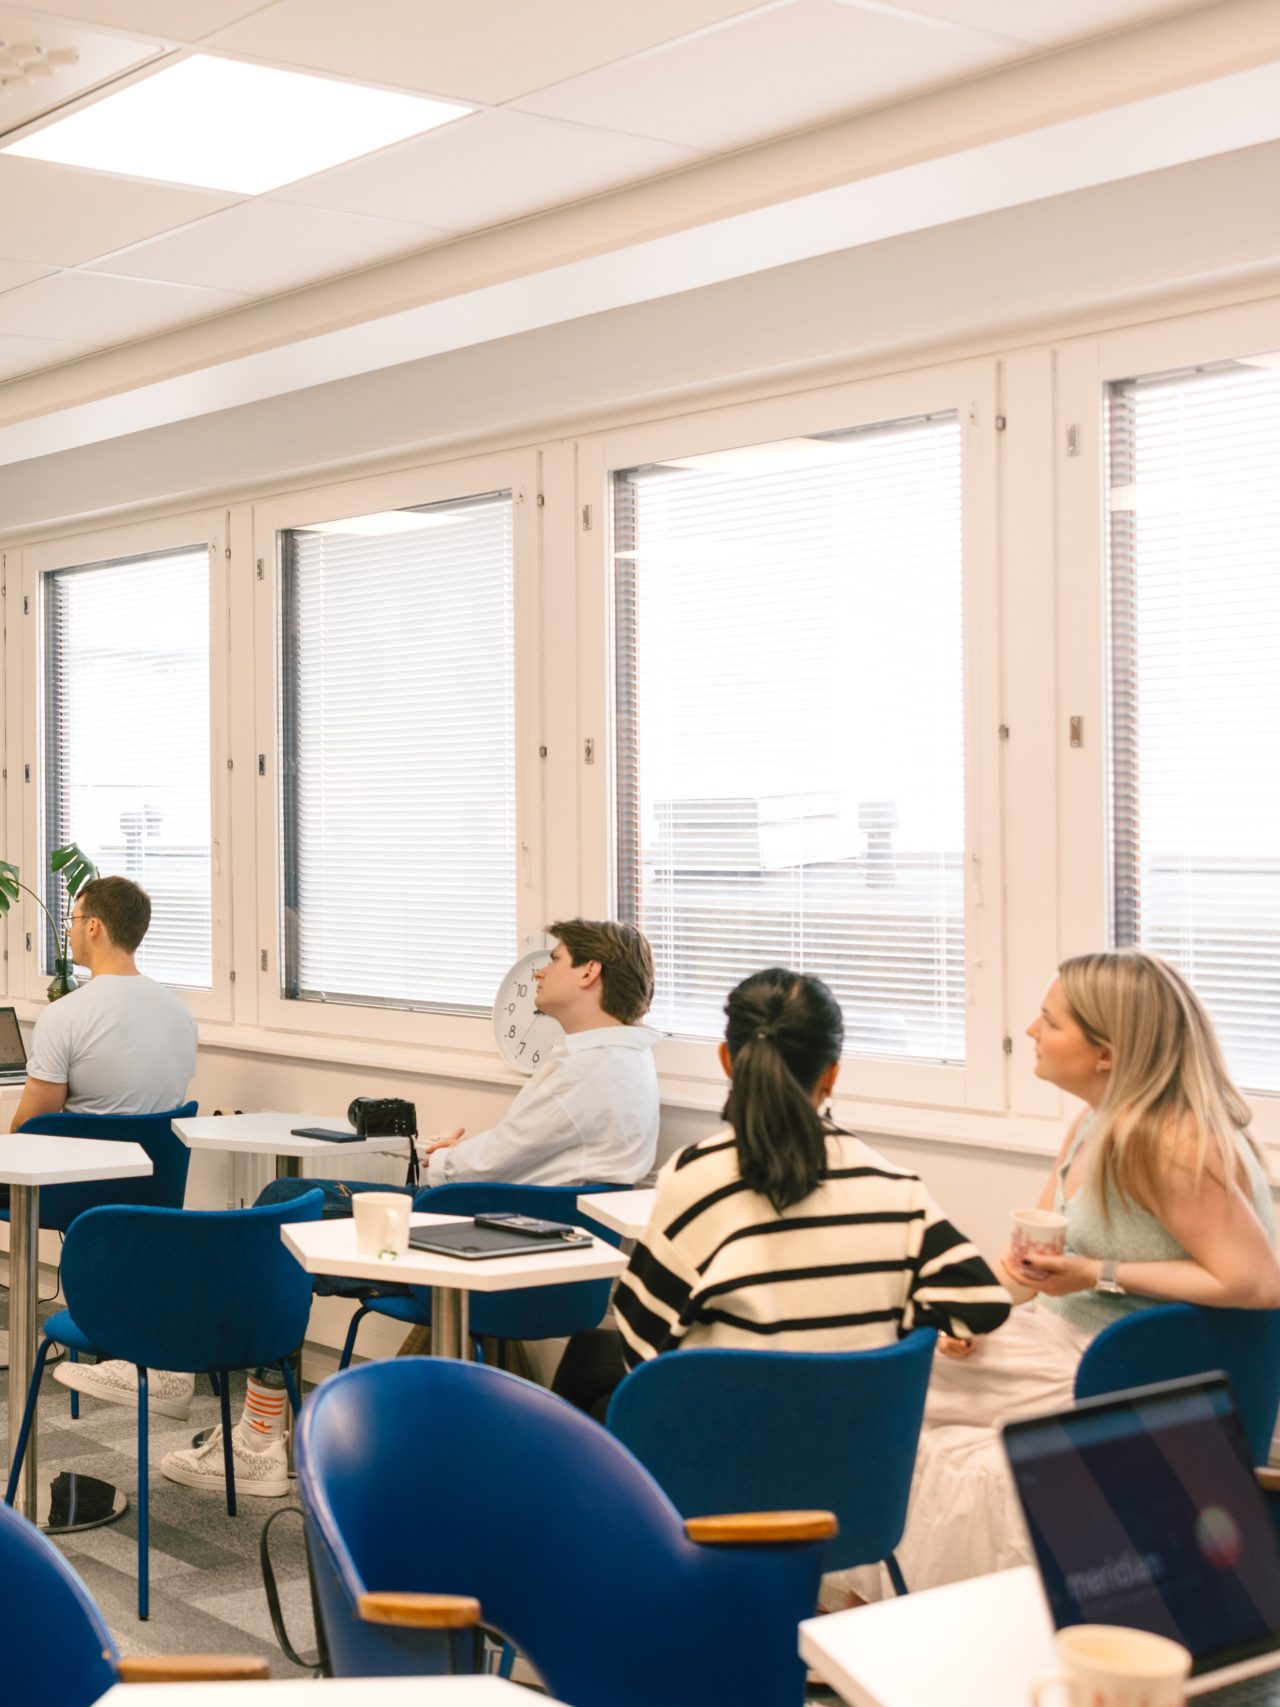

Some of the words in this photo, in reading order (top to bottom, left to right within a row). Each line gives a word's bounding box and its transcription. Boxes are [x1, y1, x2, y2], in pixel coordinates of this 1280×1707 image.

[516, 984, 528, 998] 10
[508, 1002, 515, 1016] 9
[508, 1025, 516, 1038] 8
[519, 1042, 526, 1055] 7
[532, 1050, 540, 1063] 6
